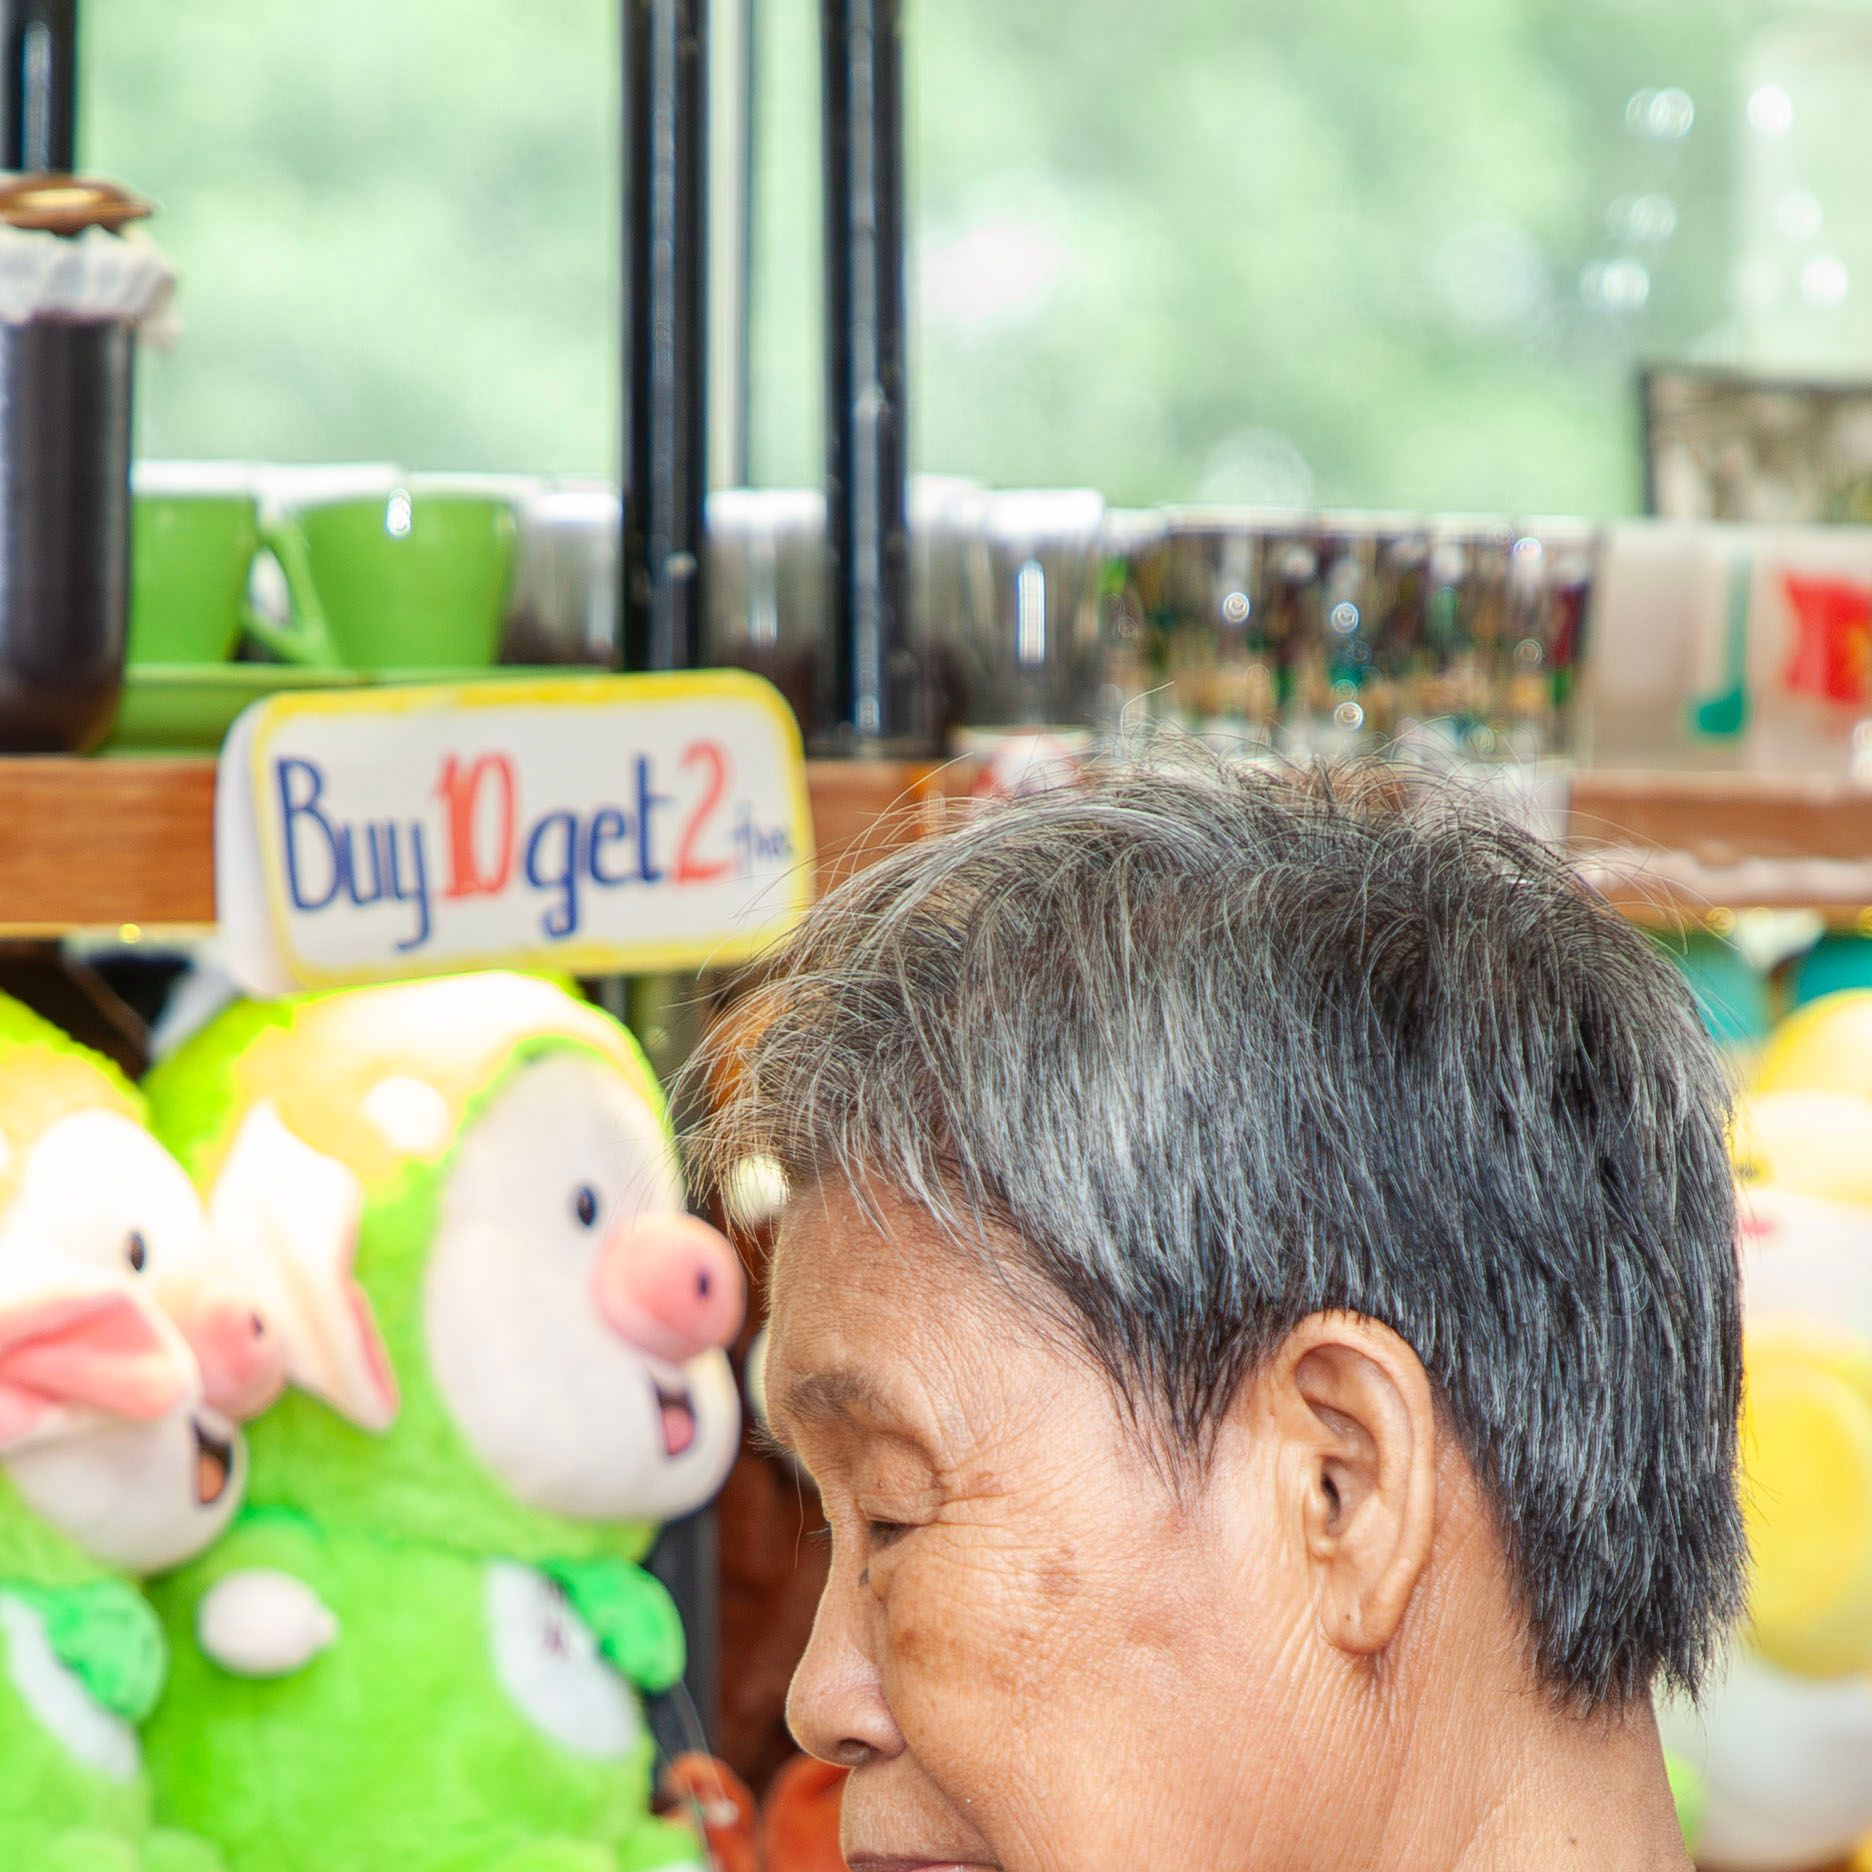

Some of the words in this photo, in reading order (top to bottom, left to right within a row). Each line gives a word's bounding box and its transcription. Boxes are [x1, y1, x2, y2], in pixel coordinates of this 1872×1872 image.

[276, 757, 433, 954] Buy
[436, 749, 520, 900] 10
[523, 754, 675, 939] get
[672, 739, 735, 885] 2
